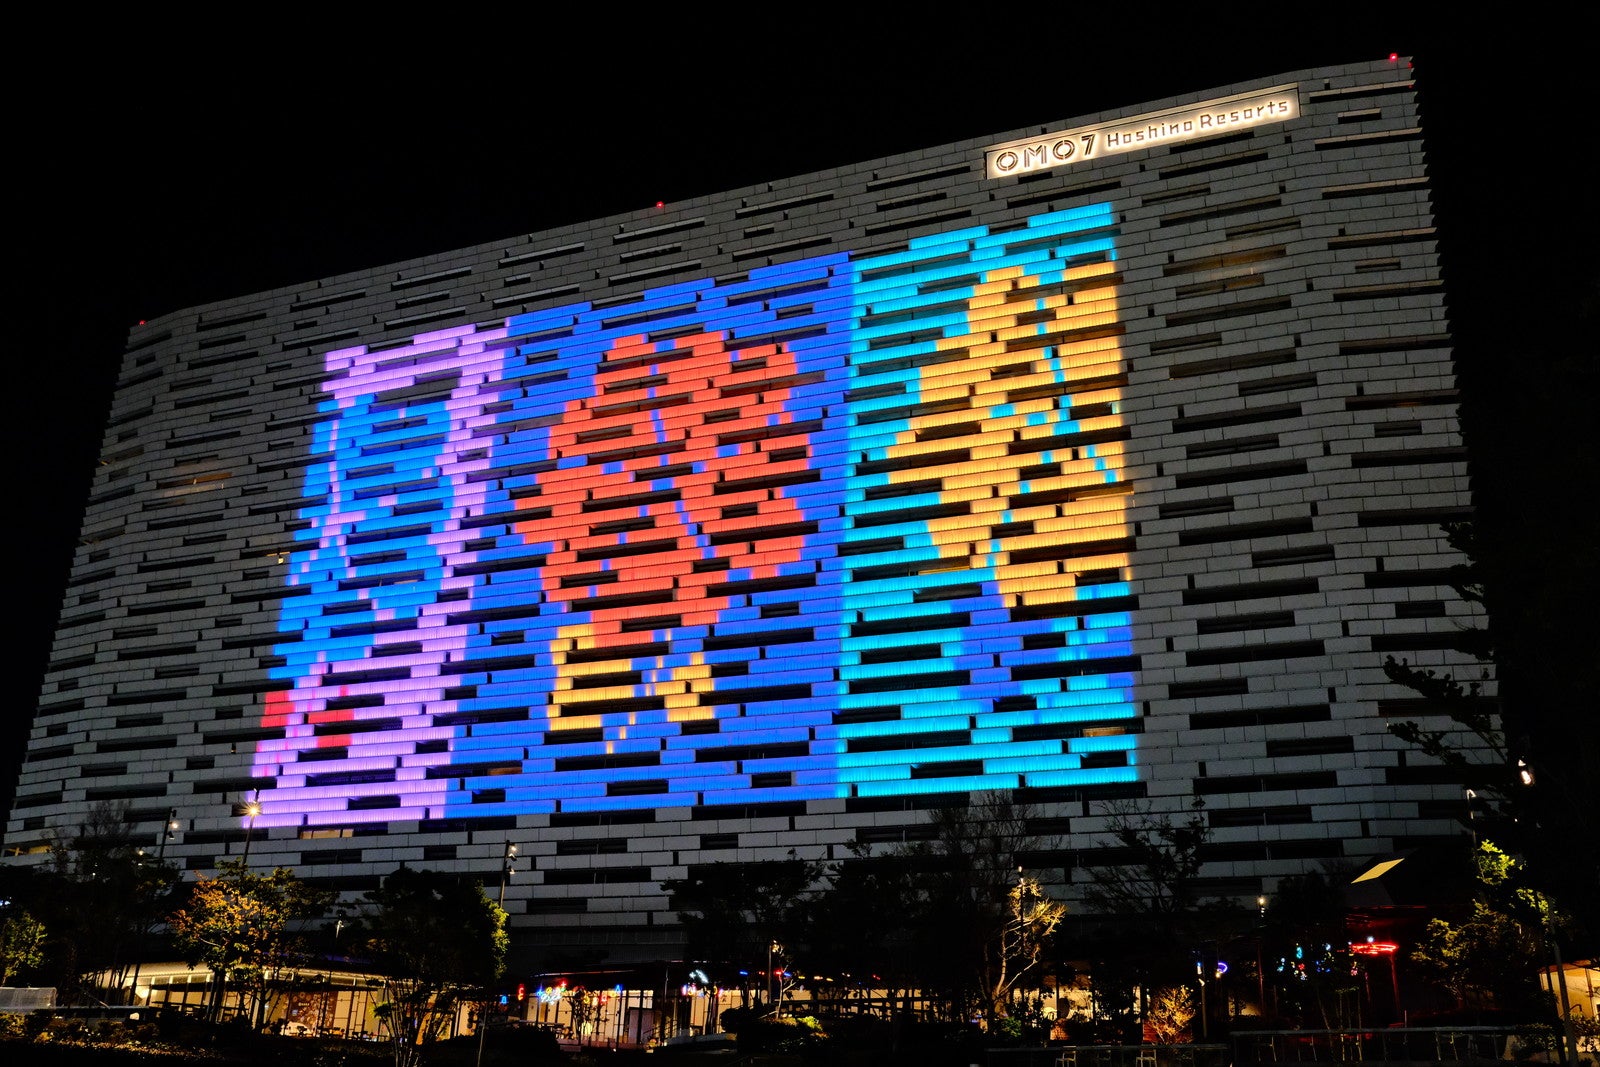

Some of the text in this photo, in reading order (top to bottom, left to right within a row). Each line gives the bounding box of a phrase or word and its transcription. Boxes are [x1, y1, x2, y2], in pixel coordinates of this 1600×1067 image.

[996, 101, 1288, 172] OMO7 Hoshino Resorts
